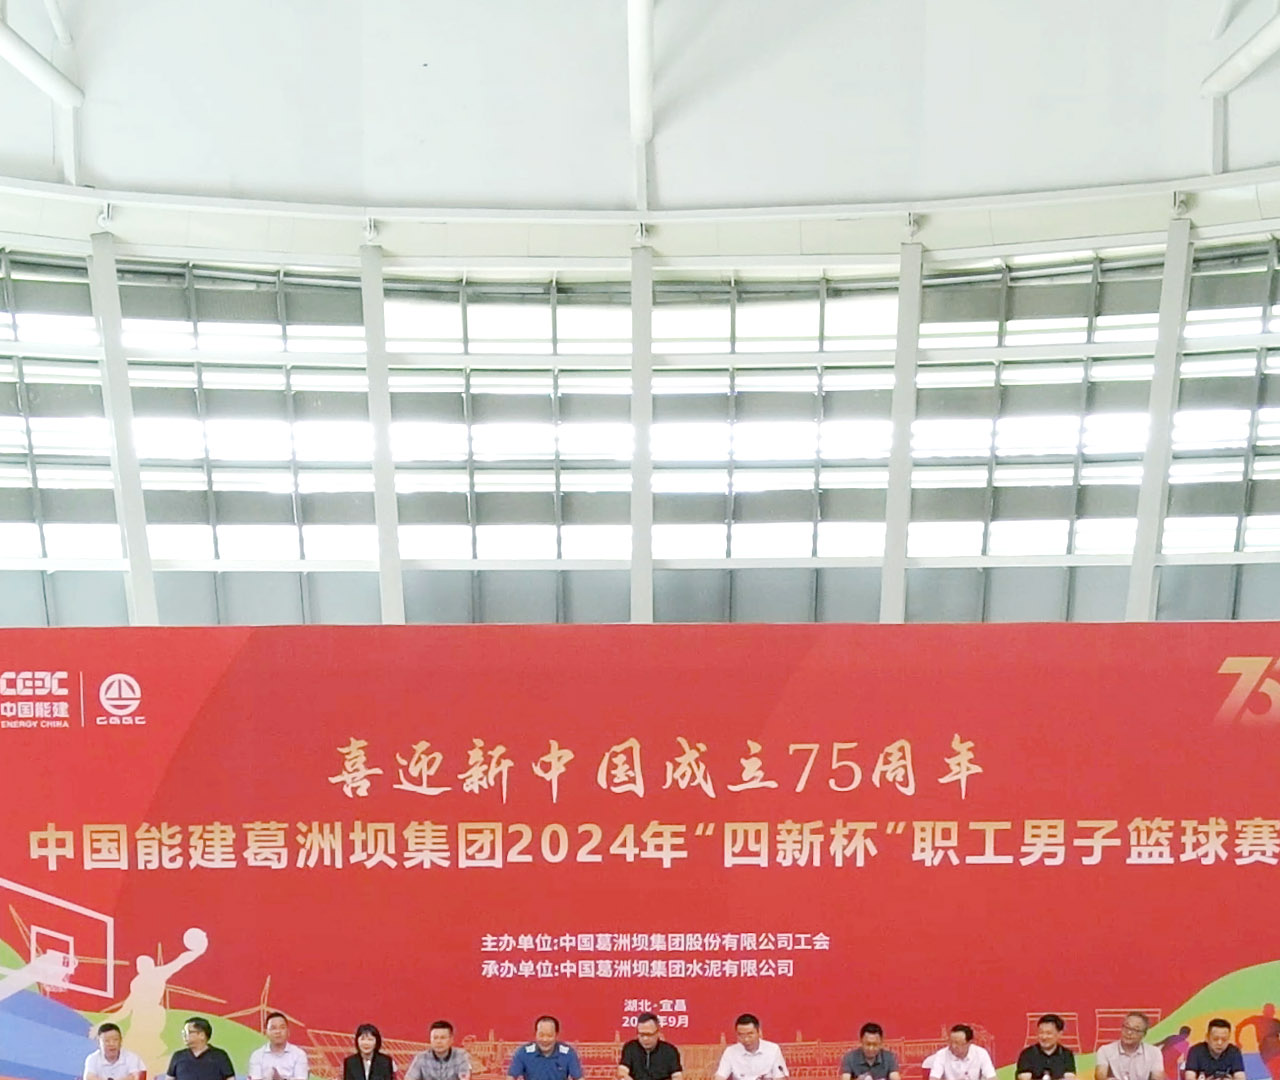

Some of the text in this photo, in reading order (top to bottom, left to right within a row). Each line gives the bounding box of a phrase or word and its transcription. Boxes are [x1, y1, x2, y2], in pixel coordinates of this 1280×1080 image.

[0, 701, 69, 718] 中国能建
[1, 719, 69, 729] ENERGY CHINA
[327, 732, 985, 804] 喜迎新中国成立75周年
[480, 932, 831, 953] 主办单位:中国葛洲坝集团股份有限公司工会
[480, 957, 794, 978] 承办单位:中国葛洲坝集团水泥有限公司
[621, 1014, 689, 1028] 20年9月
